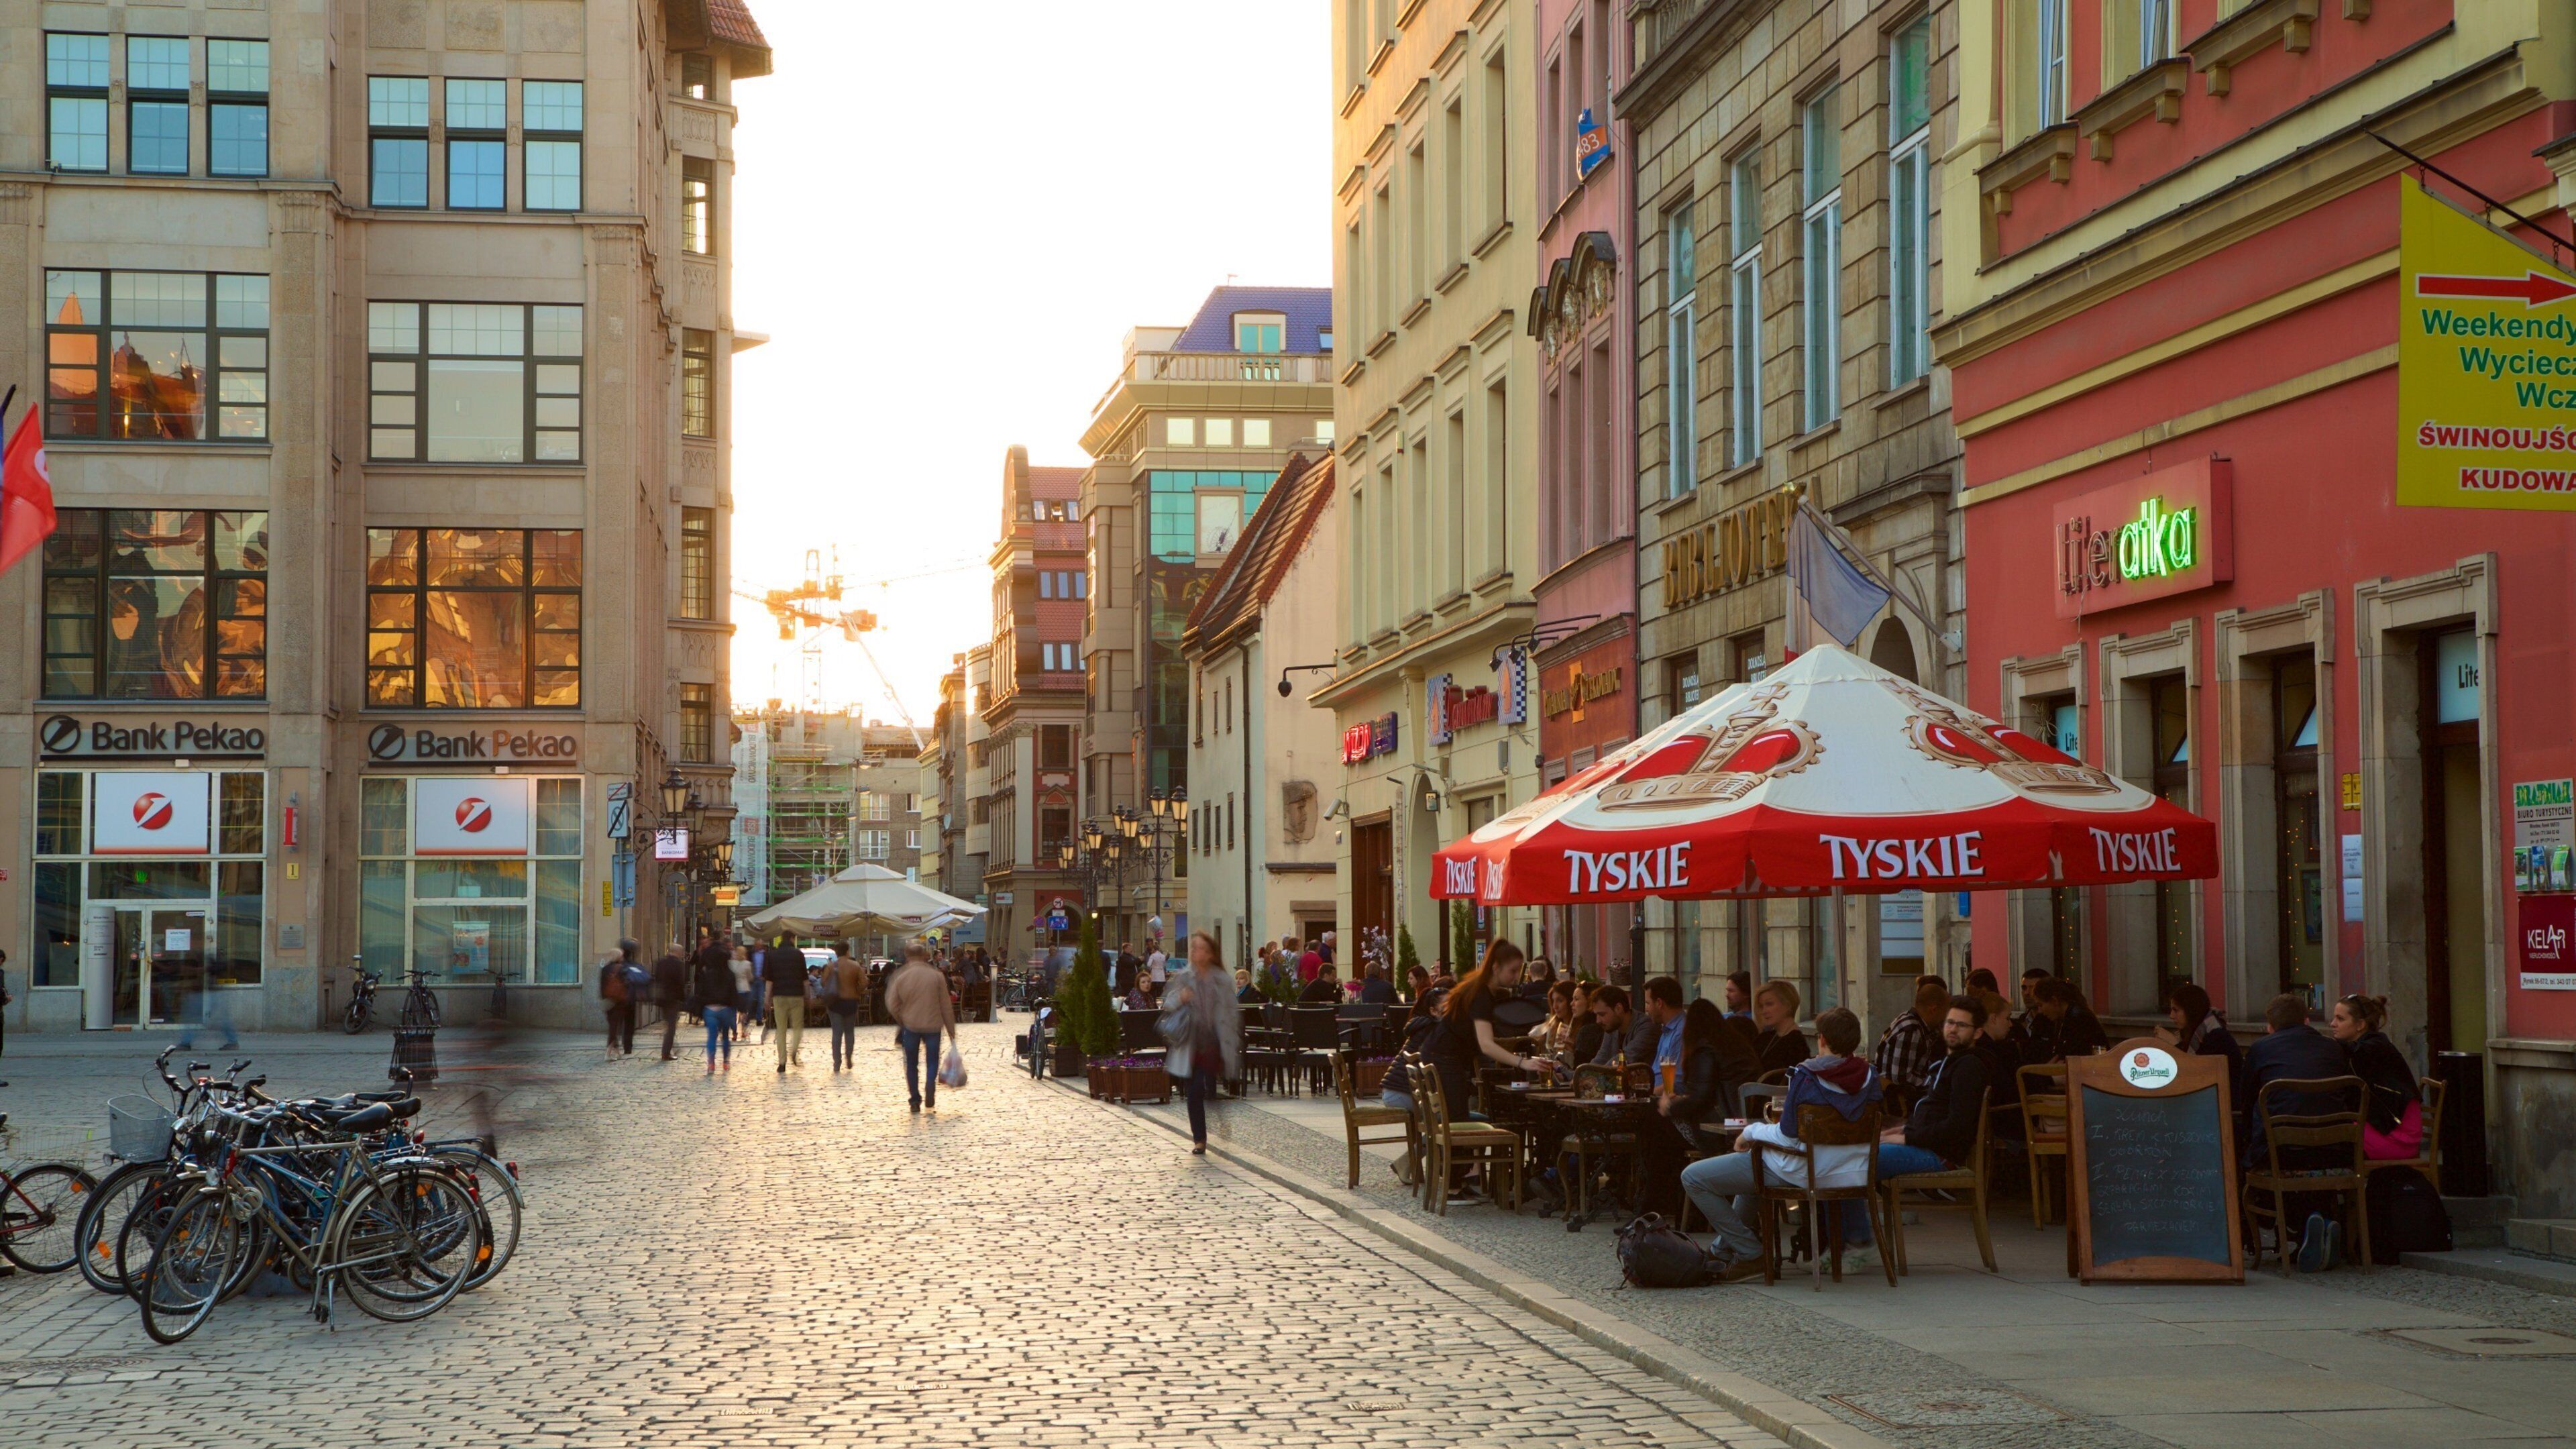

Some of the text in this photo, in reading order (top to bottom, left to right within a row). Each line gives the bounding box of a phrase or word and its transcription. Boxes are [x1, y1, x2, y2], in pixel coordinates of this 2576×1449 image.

[2421, 309, 2576, 346] Weekendy
[92, 721, 264, 751] Bank Pekao
[416, 730, 577, 758] Bank Pekao
[2518, 806, 2572, 819] BIURO TURYSTYCZNE
[1564, 841, 1691, 894] TYSKIE
[1819, 831, 1985, 880] TYSKIE
[2089, 828, 2182, 872] TYSKIE
[1446, 857, 1476, 894] TYSKIE
[2528, 924, 2565, 959] KELAR
[2131, 1067, 2169, 1081] Pilsner Urquell
